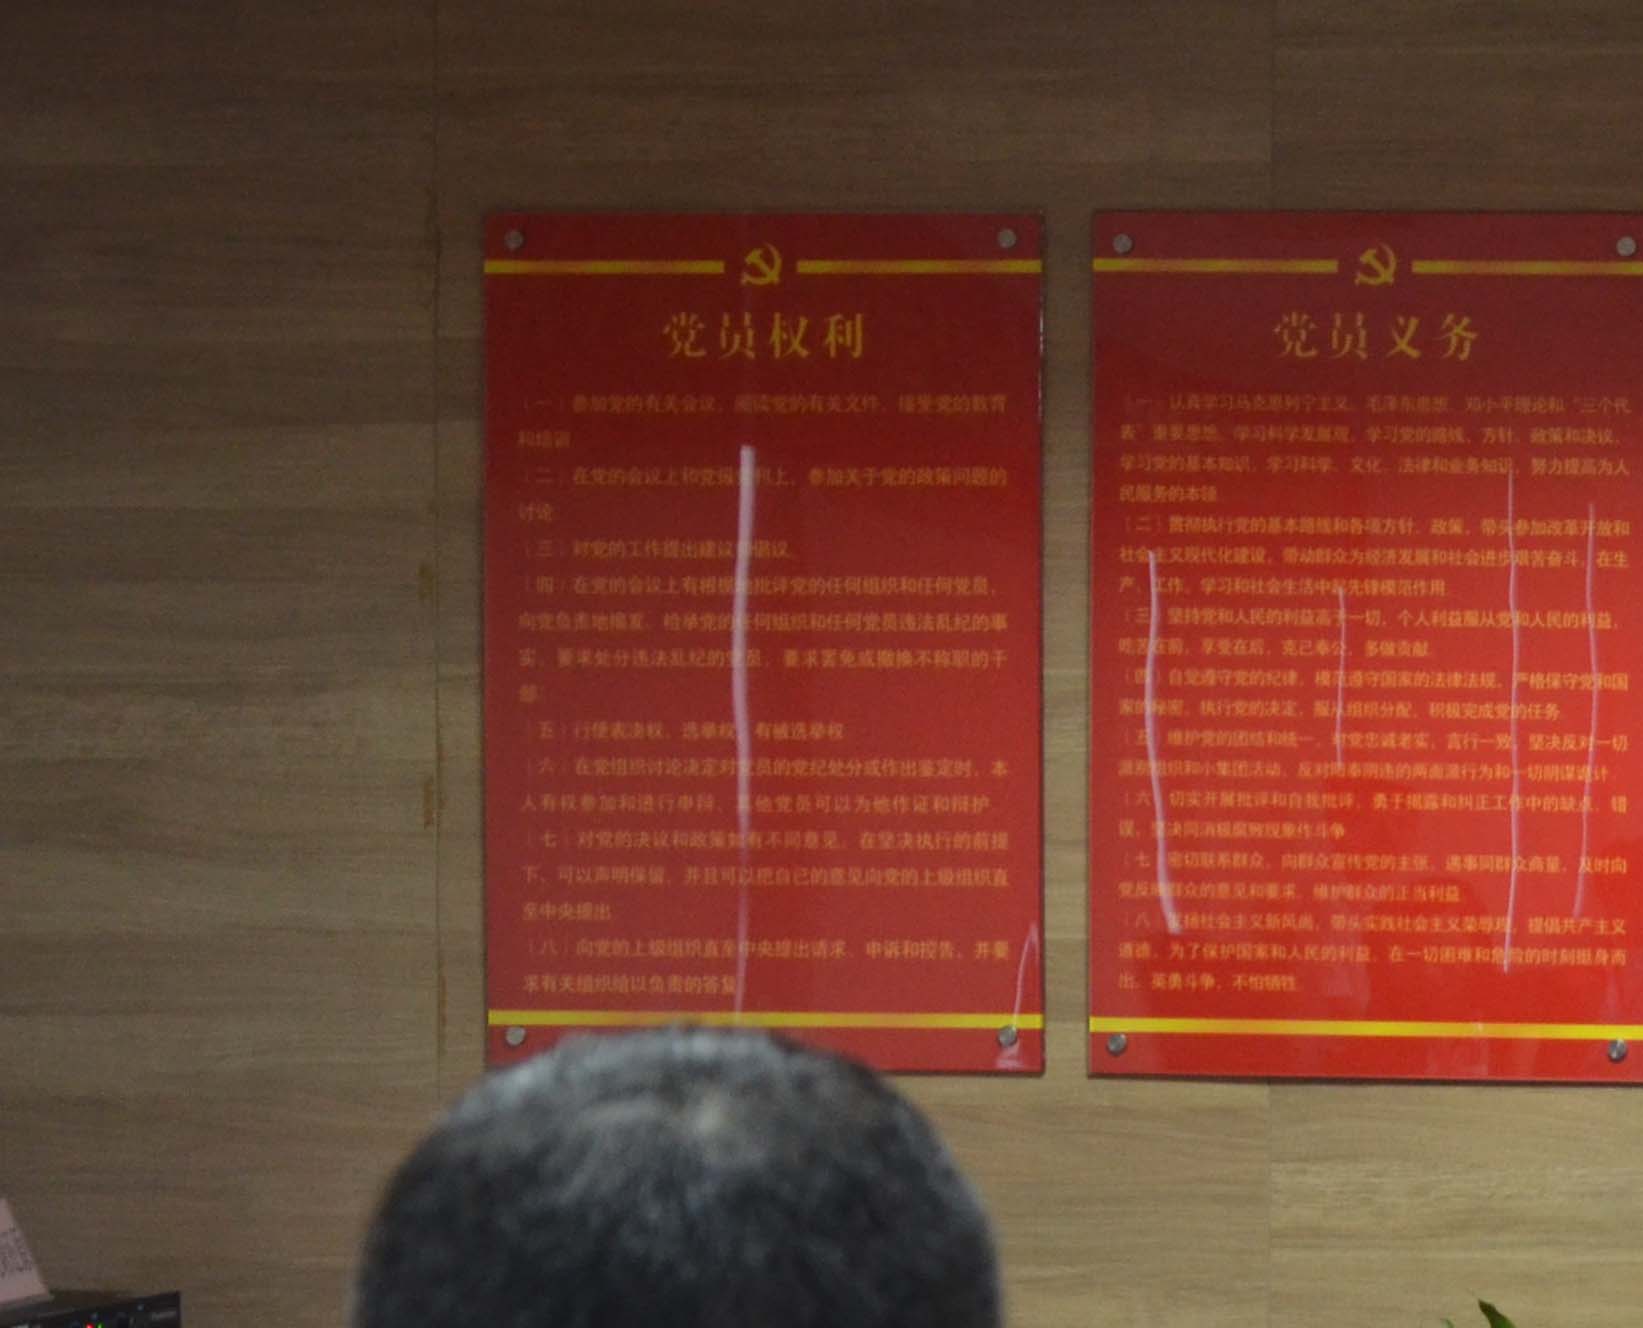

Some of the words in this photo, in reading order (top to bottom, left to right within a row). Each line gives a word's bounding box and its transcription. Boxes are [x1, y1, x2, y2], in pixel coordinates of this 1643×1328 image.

[662, 312, 865, 359] 党员权利
[1272, 310, 1480, 362] 党员义务
